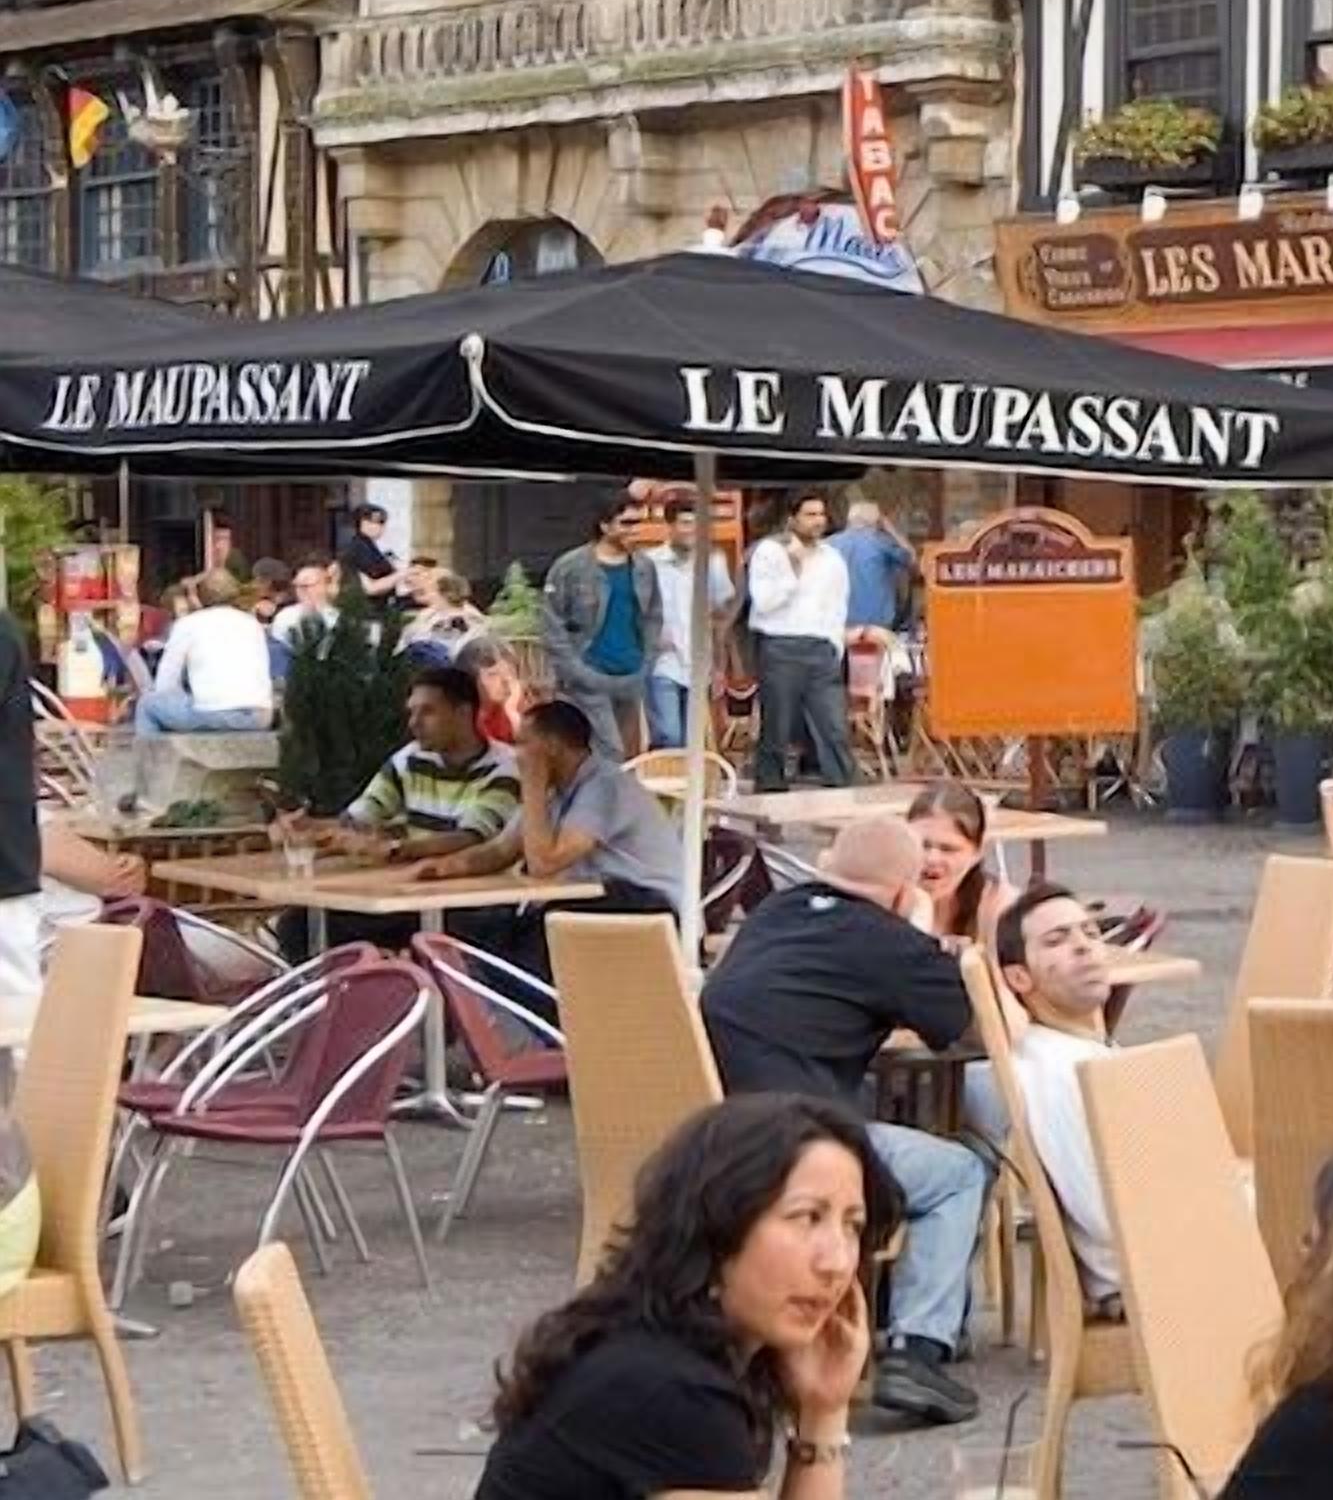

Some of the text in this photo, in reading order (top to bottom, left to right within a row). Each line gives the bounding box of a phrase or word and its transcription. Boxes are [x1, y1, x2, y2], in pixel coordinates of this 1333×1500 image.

[1141, 244, 1220, 296] LES
[41, 359, 371, 430] LE MAUPASSANT
[681, 366, 1279, 468] LE MAUPASSANT
